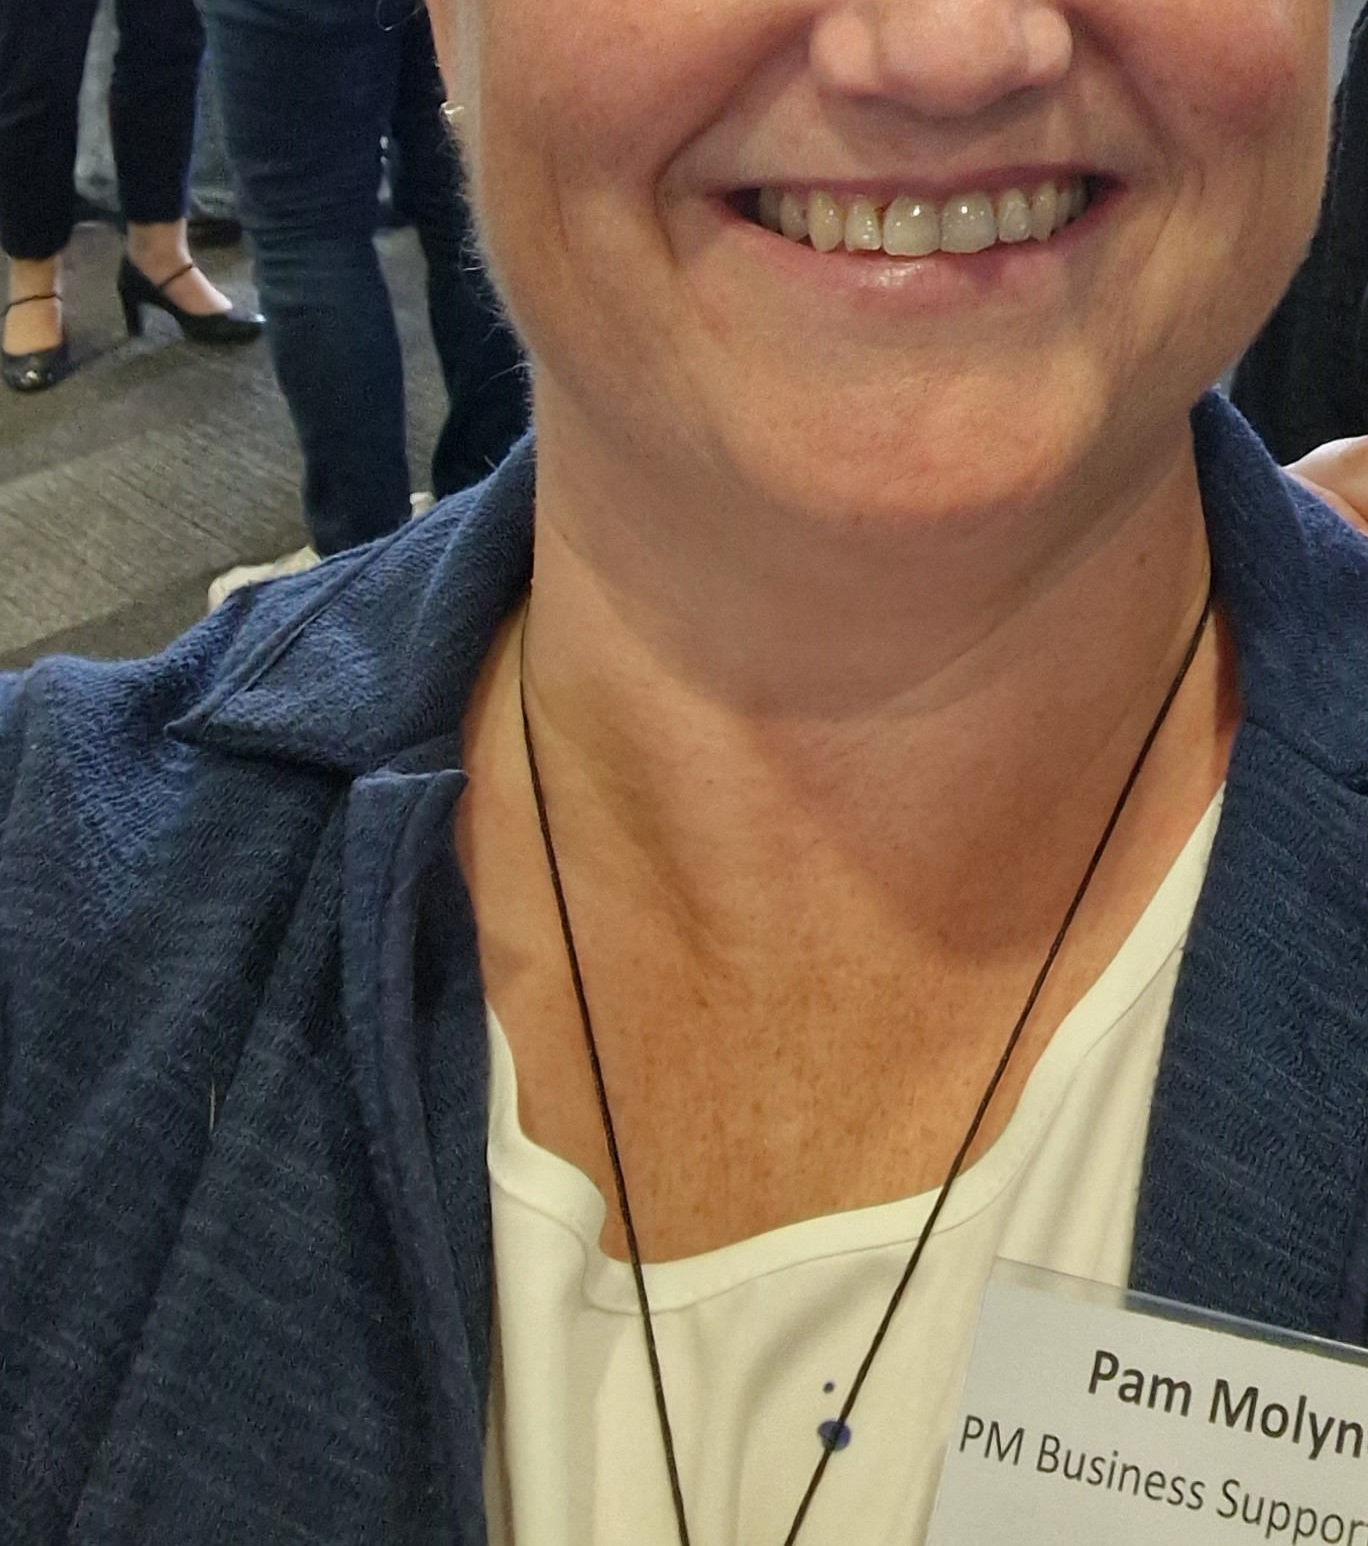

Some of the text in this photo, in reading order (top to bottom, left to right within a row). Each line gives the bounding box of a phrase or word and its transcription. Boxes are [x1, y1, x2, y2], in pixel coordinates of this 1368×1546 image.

[1088, 1349, 1192, 1417] Pam
[959, 1414, 1025, 1466] PM
[1036, 1433, 1205, 1511] Business
